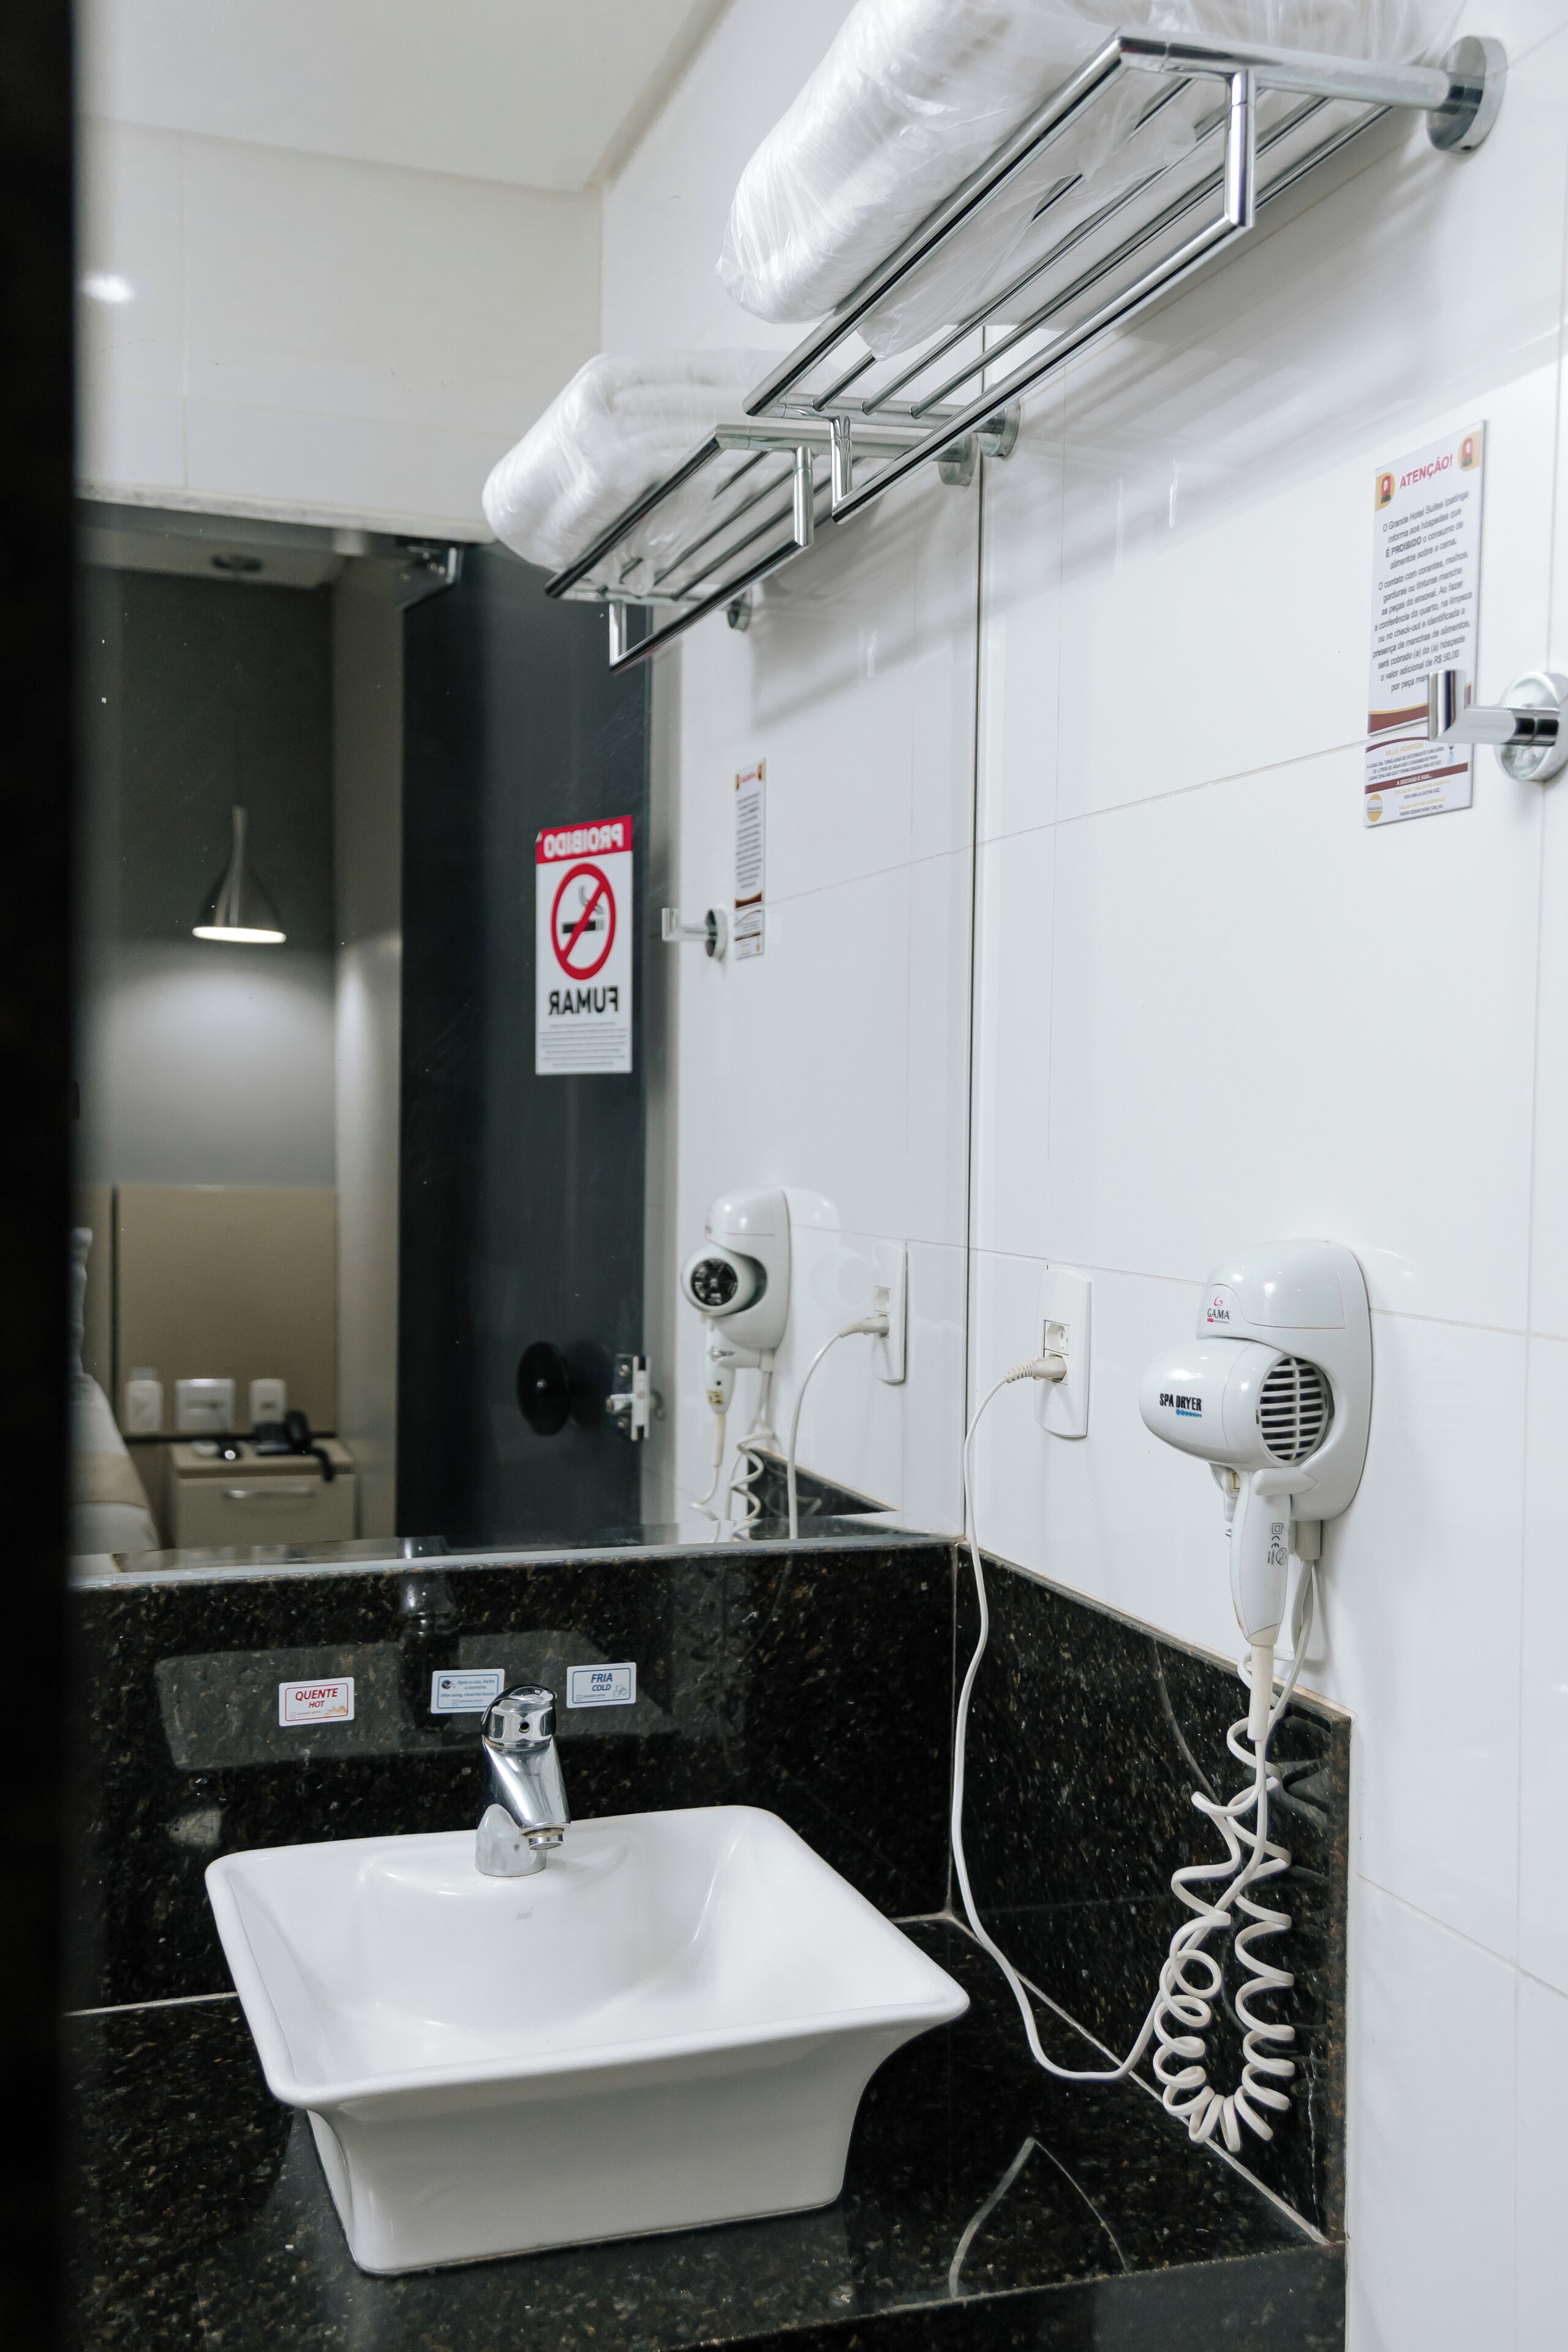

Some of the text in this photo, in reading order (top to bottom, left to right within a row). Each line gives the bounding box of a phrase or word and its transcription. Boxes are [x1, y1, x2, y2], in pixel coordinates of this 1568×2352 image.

[1399, 454, 1453, 489] ATENÇÃO!
[1382, 524, 1387, 532] O
[1389, 515, 1409, 530] Grande
[1409, 507, 1425, 521] Hotel
[1445, 491, 1469, 507] Ipatinga
[1388, 508, 1461, 544] informa aos hóspedes que
[1385, 547, 1390, 558] É
[1391, 537, 1422, 556] PROIBIDO
[1428, 524, 1455, 540] consumo
[1455, 521, 1463, 530] de
[1390, 554, 1416, 570] alimentos
[1417, 546, 1433, 559] sobre
[1439, 538, 1457, 550] cama.
[1378, 551, 1468, 590] O contato com corantes, molhos,
[1382, 567, 1462, 604] gorduras ou tinturas mancha
[1379, 612, 1409, 630] conferência
[1411, 609, 1418, 619] do
[1419, 603, 1439, 616] quarto,
[1449, 591, 1472, 605] limpeza
[1389, 601, 1405, 614] peças
[1406, 598, 1413, 607] do
[1414, 589, 1438, 603] enxoval.
[1439, 586, 1447, 595] Ao
[1448, 581, 1463, 591] fazer
[1394, 622, 1421, 637] check-out
[1427, 610, 1460, 626] identificada
[1372, 645, 1396, 660] presença
[1397, 641, 1404, 649] de
[1406, 632, 1431, 647] manchas
[1432, 629, 1439, 638] de
[1378, 660, 1389, 669] será
[1390, 652, 1412, 665] cobrado
[1422, 645, 1430, 654] do
[1440, 635, 1465, 649] hóspede
[1385, 668, 1399, 679] valor
[1400, 660, 1424, 676] adicional
[1425, 658, 1433, 667] de
[1433, 654, 1442, 665] R$
[1443, 649, 1460, 662] 50,00
[1391, 682, 1400, 693] por
[1401, 677, 1414, 690] peça
[1207, 1308, 1229, 1320] GAMA
[1159, 1393, 1202, 1411] SPA DRYER
[591, 1673, 613, 1683] FRIA
[295, 1687, 339, 1702] QUENTE
